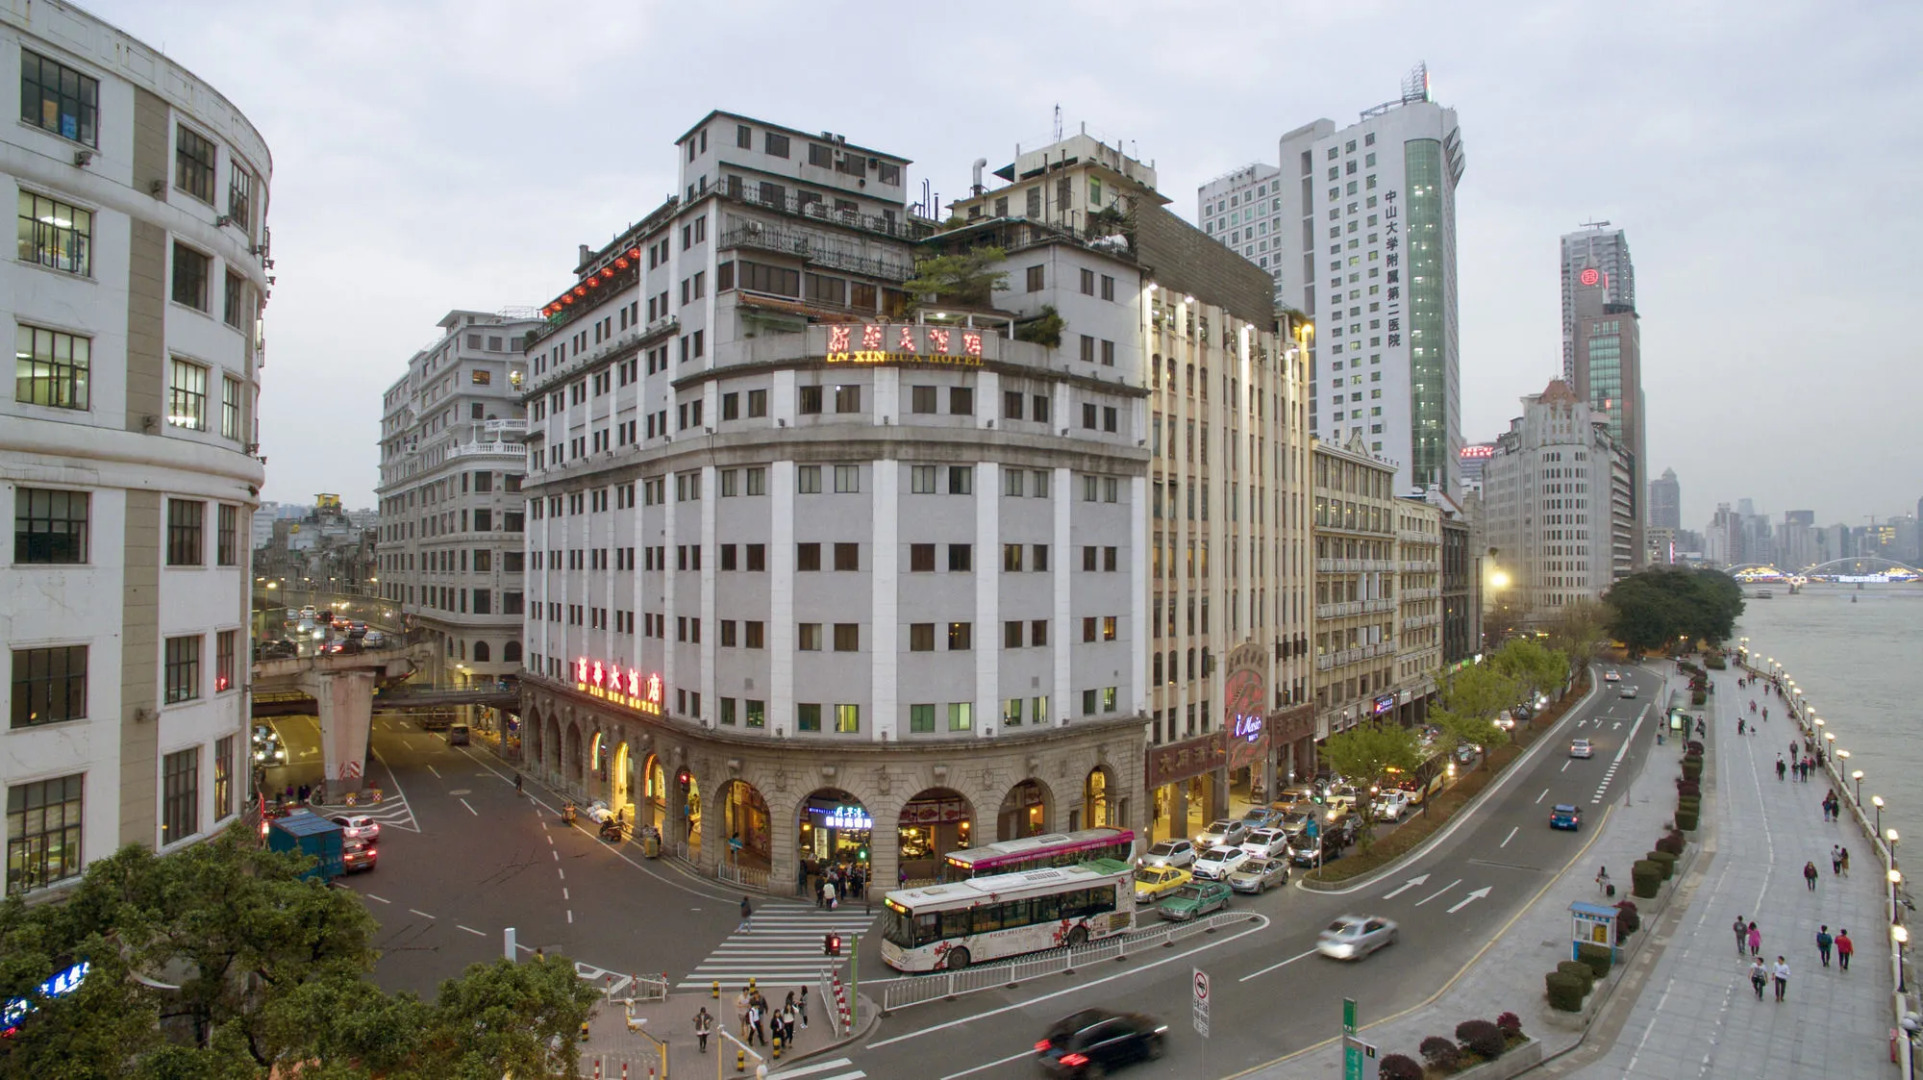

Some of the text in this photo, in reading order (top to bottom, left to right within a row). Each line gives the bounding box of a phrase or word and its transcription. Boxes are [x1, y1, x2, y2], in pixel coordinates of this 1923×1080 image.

[1385, 189, 1401, 348] 中山大学附属第二医院
[854, 351, 886, 362] XIN
[928, 354, 984, 367] HOTEL
[628, 697, 660, 715] HOTEL
